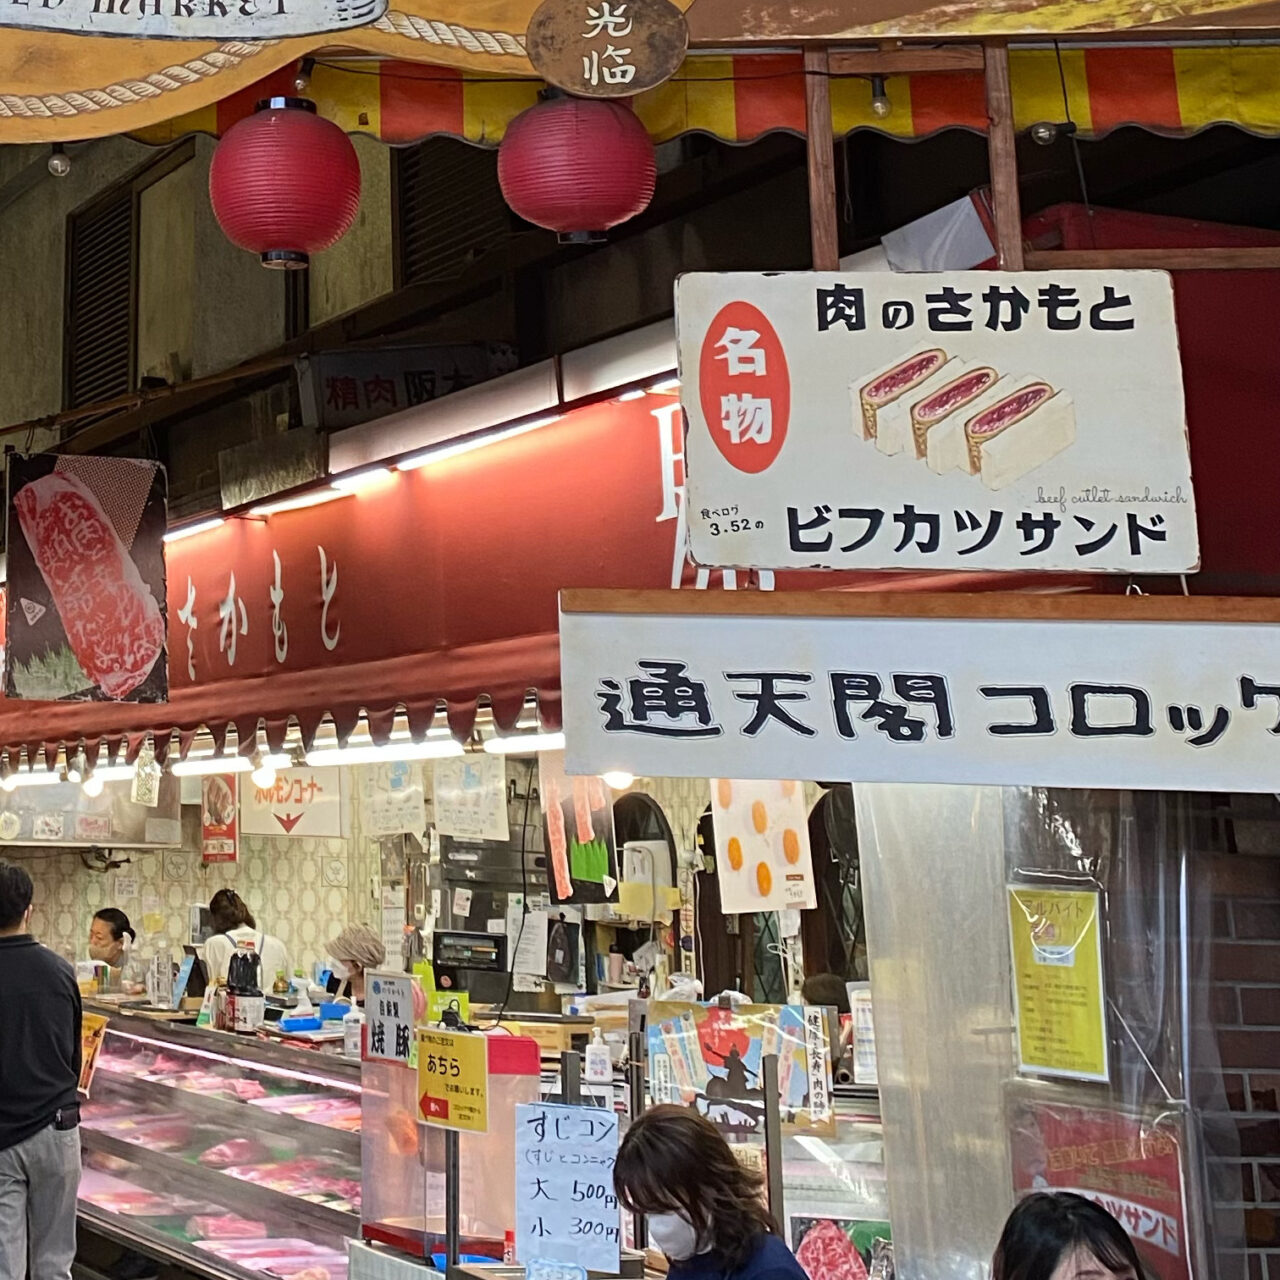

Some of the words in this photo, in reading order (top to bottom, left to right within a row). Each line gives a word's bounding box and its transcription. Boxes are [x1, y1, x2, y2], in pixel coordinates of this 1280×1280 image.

[815, 283, 1136, 332] 肉のさかもと
[713, 326, 774, 445] 名物
[701, 505, 740, 521] 食べログ
[1035, 486, 1068, 513] beef
[1114, 486, 1188, 504] sandwich
[786, 504, 1168, 558] ビフカツサンド
[426, 1051, 461, 1077] あちら
[526, 1111, 616, 1143] すじコン
